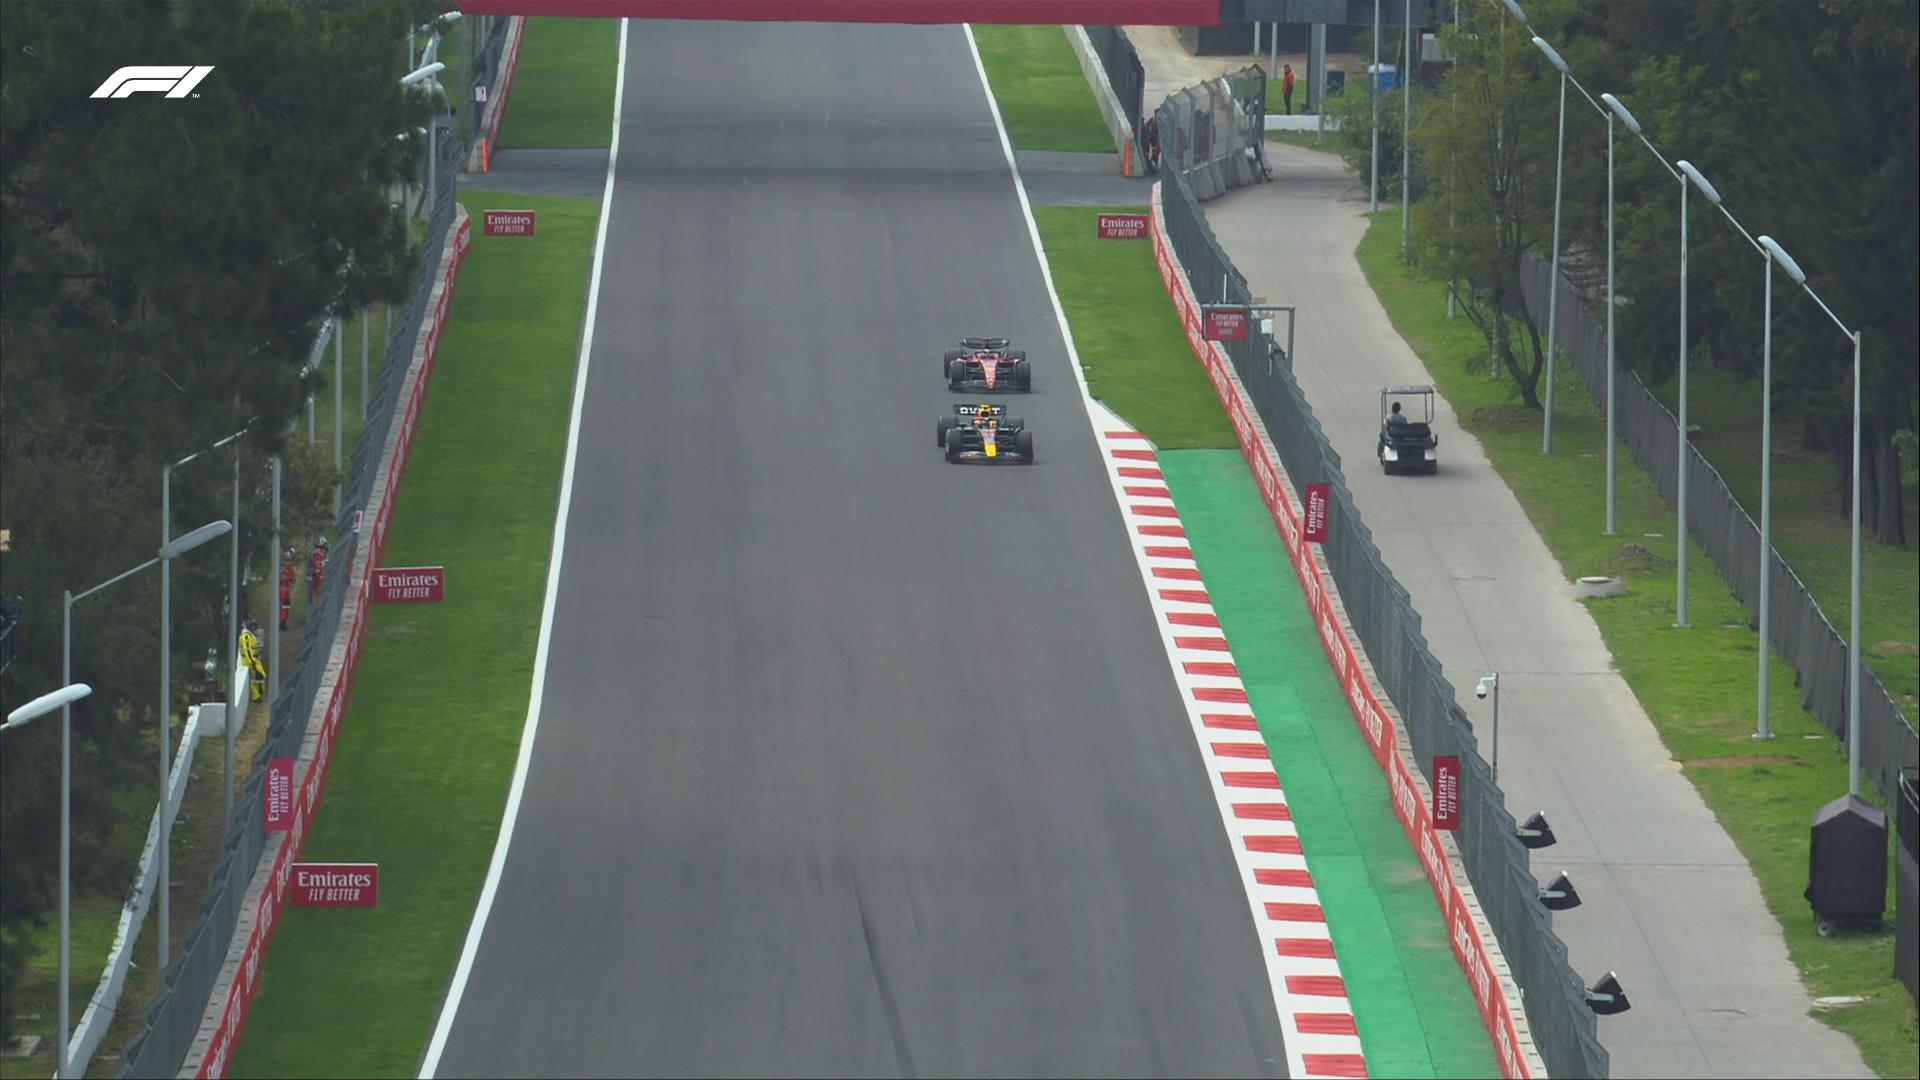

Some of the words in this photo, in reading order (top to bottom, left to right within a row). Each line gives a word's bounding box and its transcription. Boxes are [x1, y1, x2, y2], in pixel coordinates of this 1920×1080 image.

[488, 214, 531, 224] Emirates
[1101, 218, 1144, 228] Emirates
[1307, 491, 1318, 534] Emirates
[379, 574, 439, 587] Emirates
[388, 588, 401, 598] FLY
[403, 587, 430, 598] BETTER
[268, 768, 279, 821] Emirates
[1437, 767, 1448, 819] Emirates
[1448, 776, 1456, 800] BETTER
[1448, 801, 1456, 813] FLY
[298, 871, 371, 887] Emirates
[308, 888, 325, 901] FLY
[327, 888, 360, 901] BETTER
